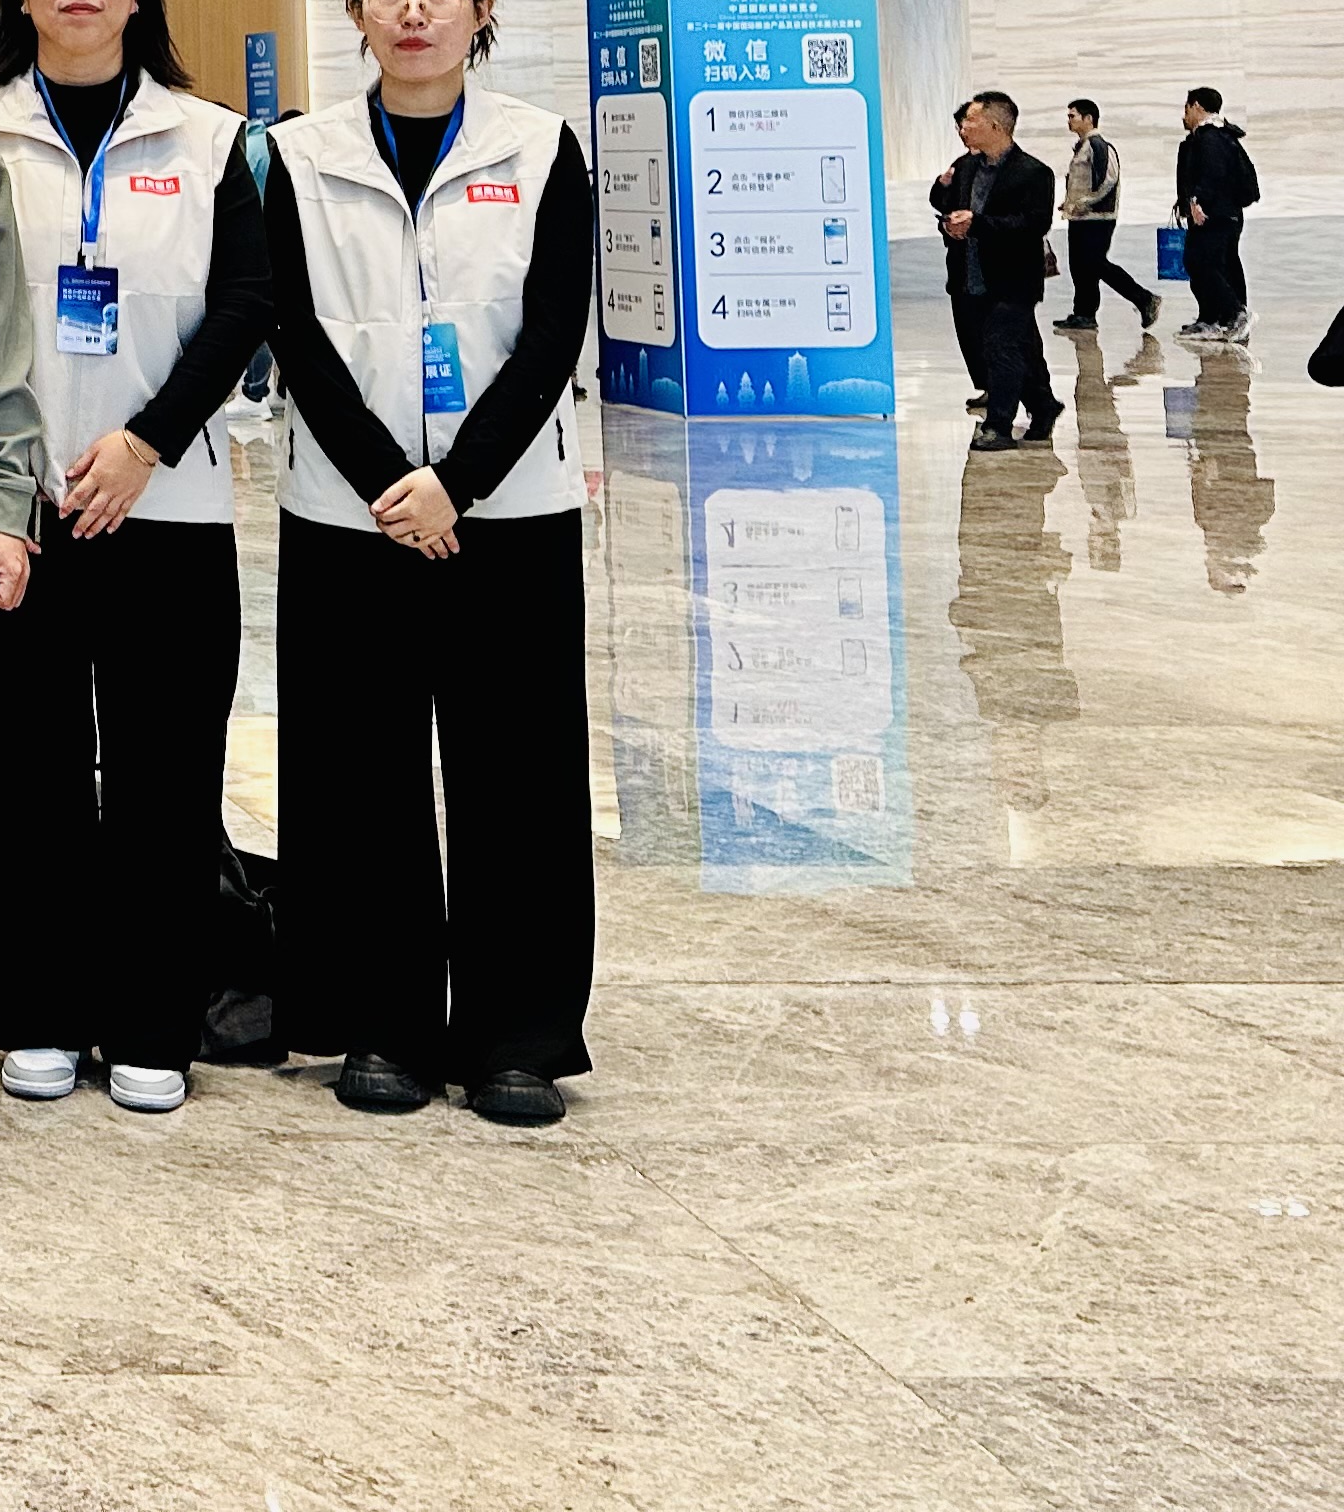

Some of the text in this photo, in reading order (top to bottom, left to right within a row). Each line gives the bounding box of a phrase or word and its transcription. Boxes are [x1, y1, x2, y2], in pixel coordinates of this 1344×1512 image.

[704, 39, 768, 63] 微信
[705, 64, 771, 83] 扫码入场
[706, 107, 715, 132] 1
[604, 169, 611, 194] 2
[707, 169, 723, 195] 2
[606, 228, 613, 253] 3
[710, 232, 726, 257] 3
[608, 288, 615, 312] 4
[712, 294, 729, 320] 4
[425, 364, 453, 379] 展证
